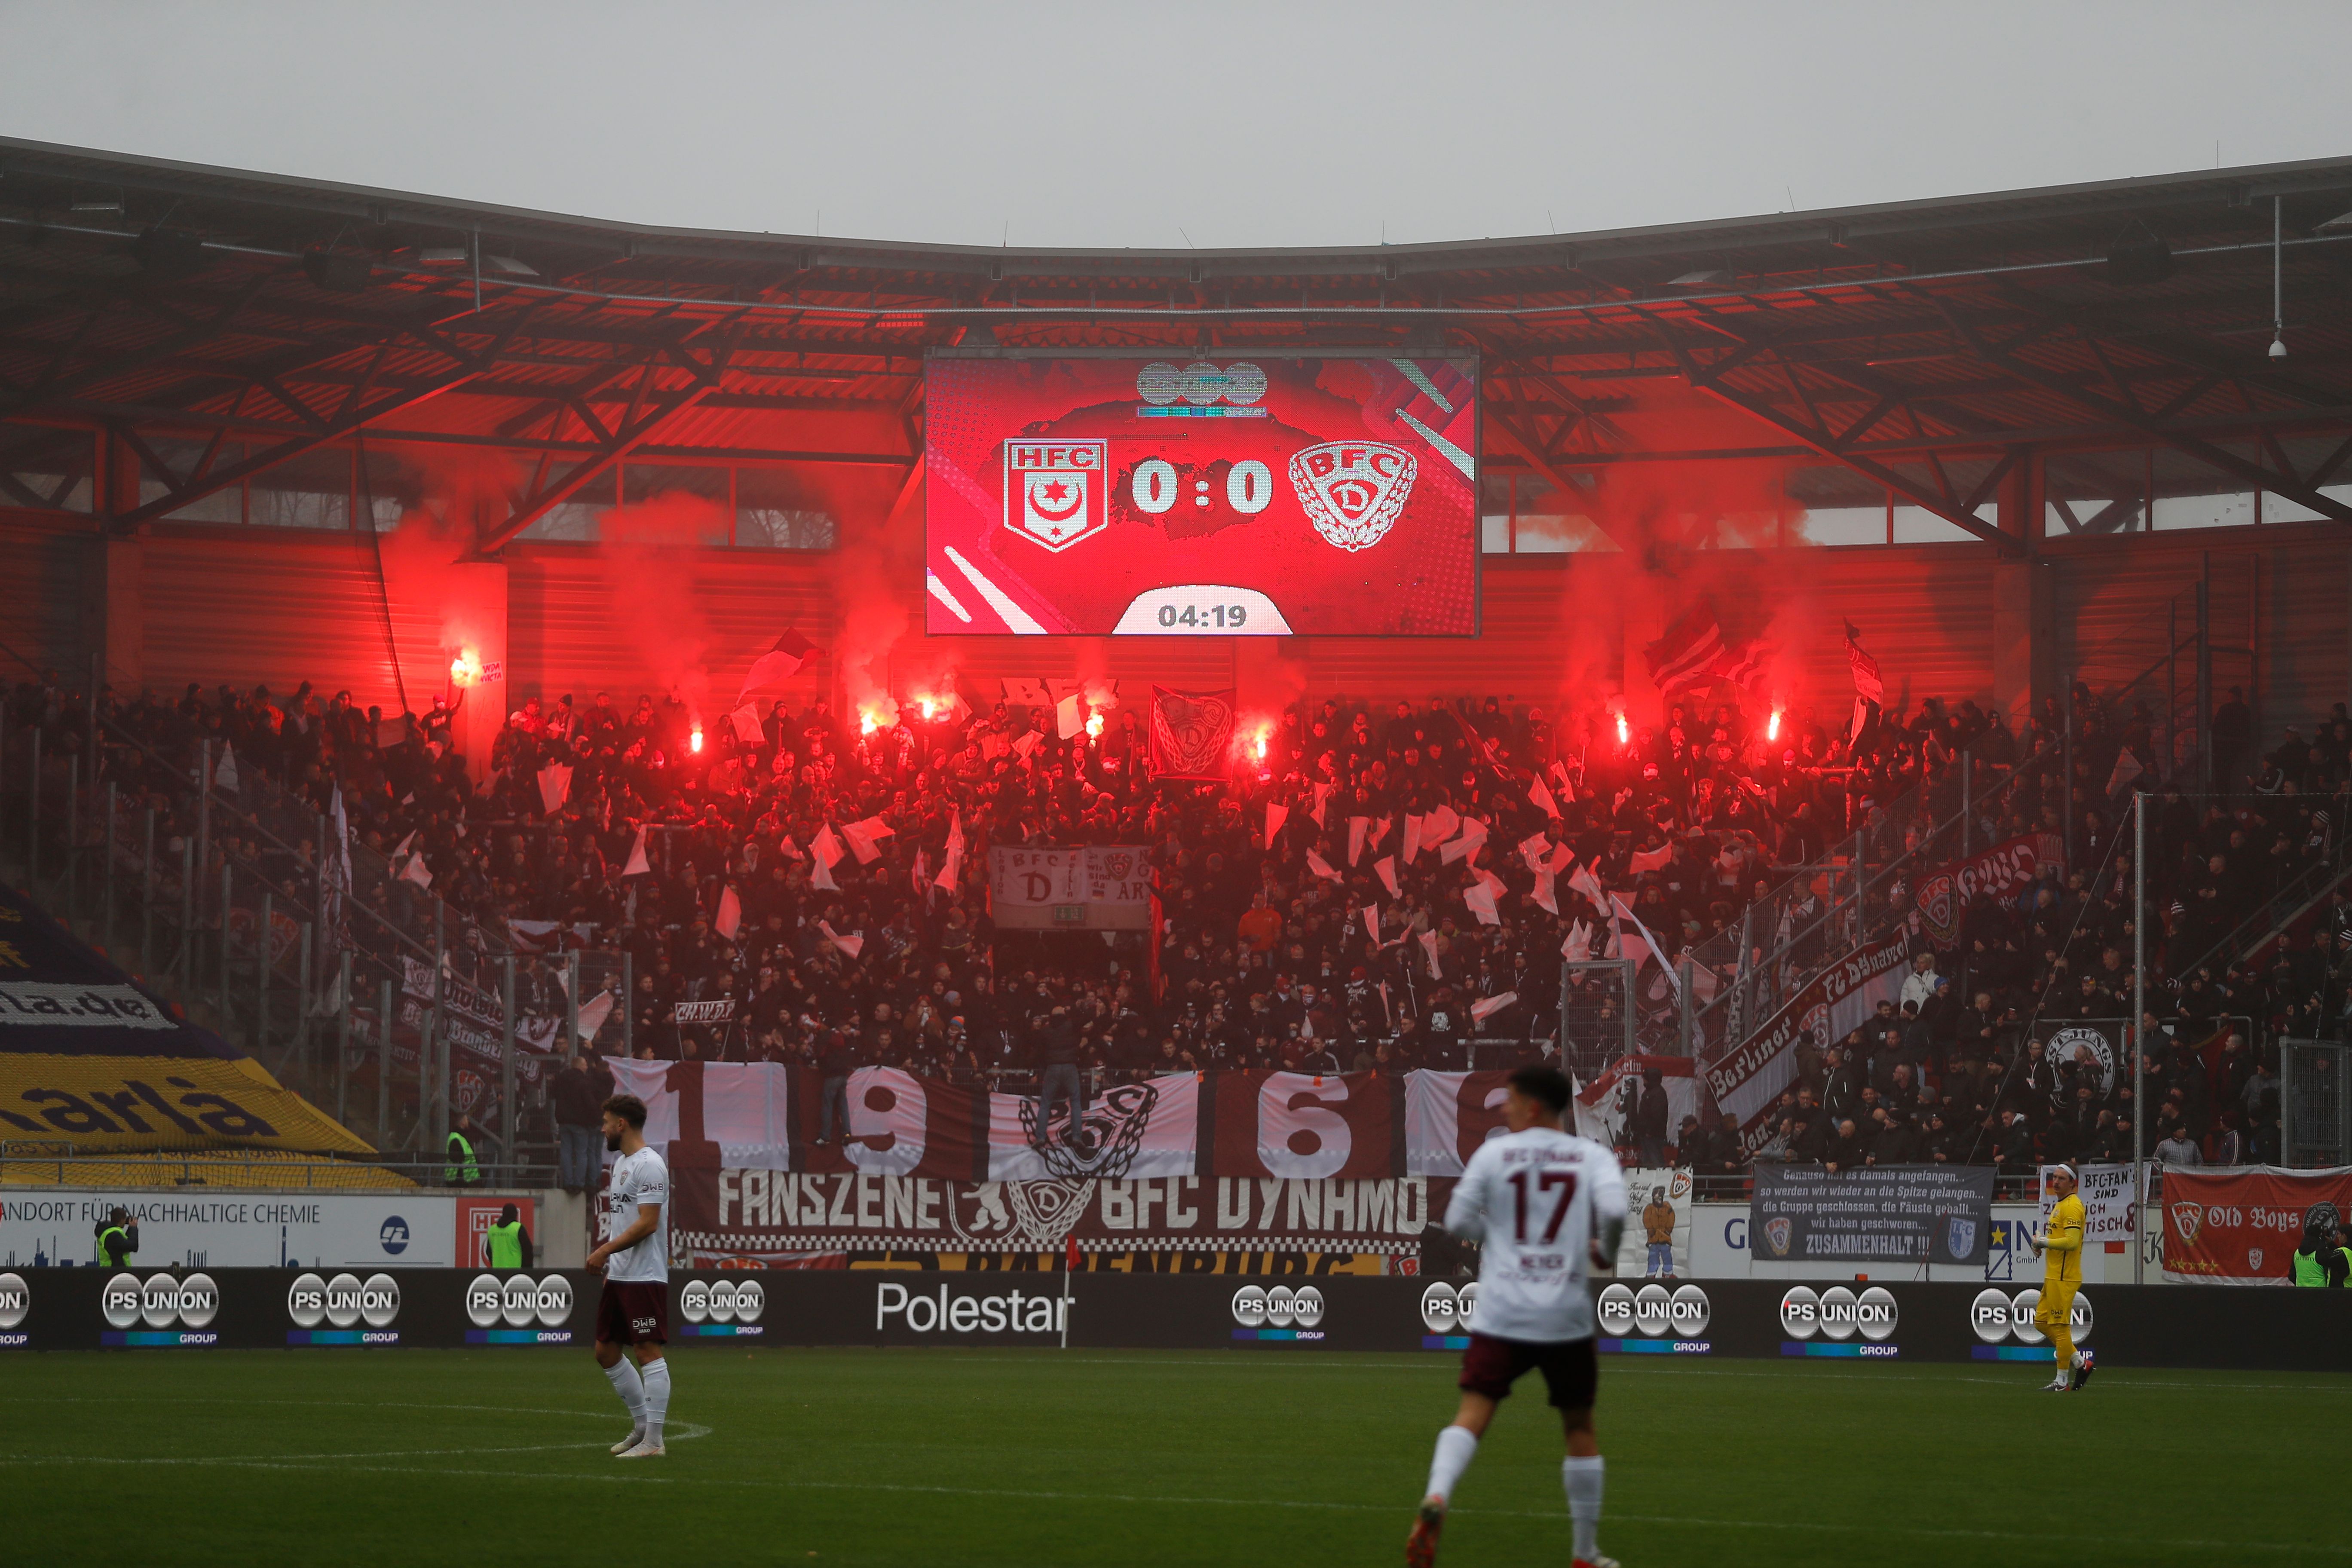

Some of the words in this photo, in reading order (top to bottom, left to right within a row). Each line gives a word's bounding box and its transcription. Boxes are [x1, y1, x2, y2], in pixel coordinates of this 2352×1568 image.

[1017, 448, 1094, 467] HFC
[1306, 450, 1400, 478] BFC
[1158, 606, 1246, 628] 04:19
[1012, 853, 1058, 867] BFC
[1709, 1015, 1791, 1098] Berliner
[1822, 970, 1846, 1002] FC
[1784, 1170, 1824, 1180] Genauso
[1846, 1172, 1857, 1180] es
[1860, 1170, 1896, 1180] damals
[718, 1169, 940, 1229] FANSZENE
[1760, 1188, 1771, 1196] so
[1774, 1185, 1808, 1196] werden
[1812, 1185, 1827, 1196] wir
[1830, 1185, 1862, 1196] wieder
[1864, 1188, 1876, 1196] an
[1879, 1185, 1894, 1196] die
[1897, 1185, 1927, 1198] Spitze
[1930, 1187, 1984, 1200] gelangen...
[2093, 1188, 2118, 1199] SIND
[82, 1198, 113, 1221] FÜR
[122, 1203, 248, 1222] NACHHALTIGE
[254, 1204, 320, 1223] CHEMIE
[1101, 1176, 1199, 1229] BFC
[1217, 1176, 1427, 1234] DYNAMO
[1507, 1170, 1577, 1244] 17
[1763, 1201, 1777, 1212] die
[1780, 1201, 1813, 1214] Gruppe
[1816, 1201, 1877, 1214] geschlossen,
[1882, 1201, 1896, 1212] die
[1899, 1202, 1932, 1213] Fäuste
[2175, 1205, 2200, 1218] BFC
[1811, 1217, 1825, 1228] wir
[1829, 1217, 1858, 1228] haben
[1861, 1218, 1927, 1231] geschworen...
[2208, 1206, 2242, 1227] Old
[2250, 1206, 2300, 1232] Boys
[1806, 1234, 1913, 1255] ZUSAMMENHALT
[110, 1292, 137, 1310] PS
[144, 1292, 210, 1310] UNION
[295, 1291, 322, 1309] PS
[328, 1291, 392, 1309] UNION
[473, 1292, 498, 1309] PS
[504, 1292, 565, 1309] UNION
[686, 1295, 706, 1308] PS
[710, 1295, 759, 1308] UNION
[877, 1283, 1076, 1332] Polestar
[1239, 1298, 1264, 1313] PS
[1268, 1298, 1318, 1313] UNION
[1428, 1298, 1454, 1316] PS
[1605, 1301, 1631, 1319] PS
[1637, 1301, 1702, 1319] UNION
[1788, 1304, 1815, 1322] PS
[1822, 1304, 1889, 1322] UNION
[1979, 1306, 2006, 1324] PS
[180, 1334, 217, 1344] GROUP
[362, 1332, 398, 1342] GROUP
[537, 1332, 571, 1342] GROUP
[736, 1326, 763, 1335] GROUP
[1295, 1331, 1324, 1339] GROUP
[1673, 1342, 1710, 1352] GROUP
[1859, 1345, 1898, 1356] GROUP
